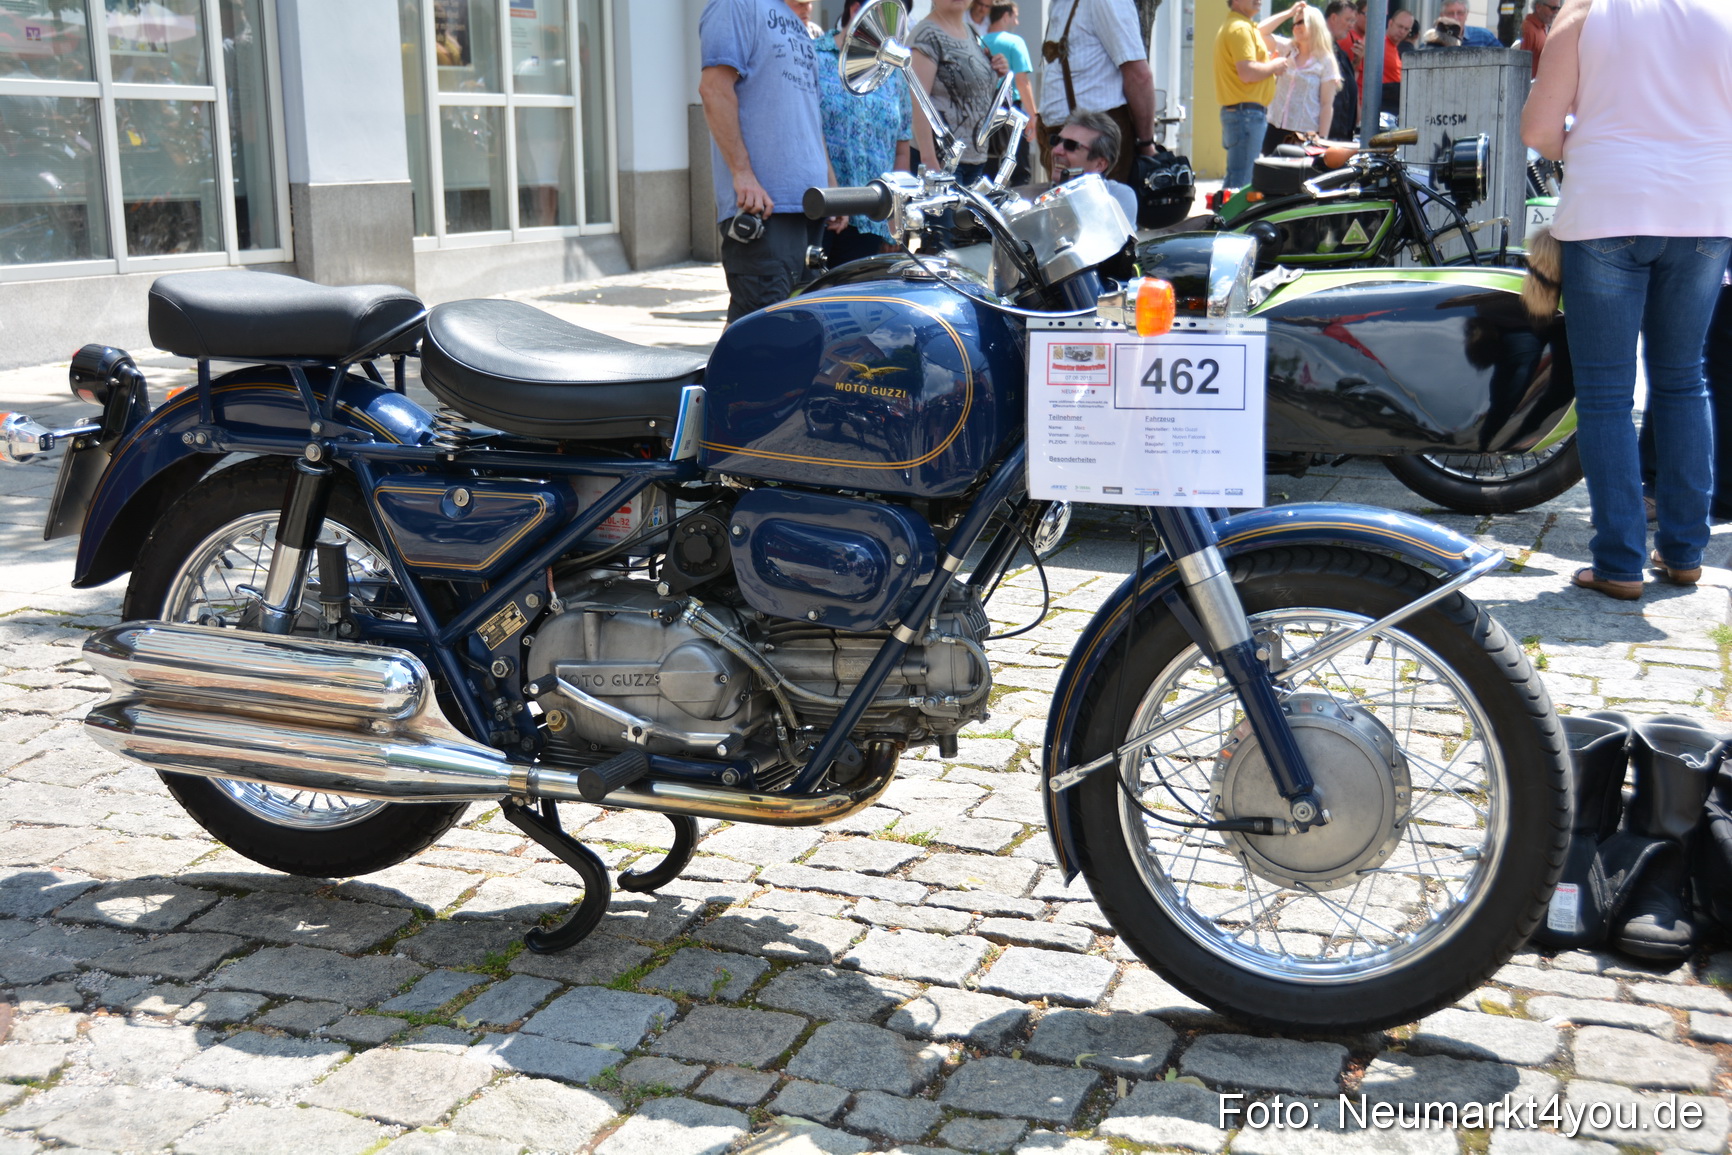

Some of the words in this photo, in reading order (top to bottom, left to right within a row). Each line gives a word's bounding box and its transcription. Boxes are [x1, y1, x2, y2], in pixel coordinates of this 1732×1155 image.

[1425, 114, 1467, 126] FASCISM
[1141, 358, 1219, 395] 462
[835, 382, 867, 394] MOTO
[871, 386, 906, 399] GUZZI
[612, 673, 659, 688] GUZZ
